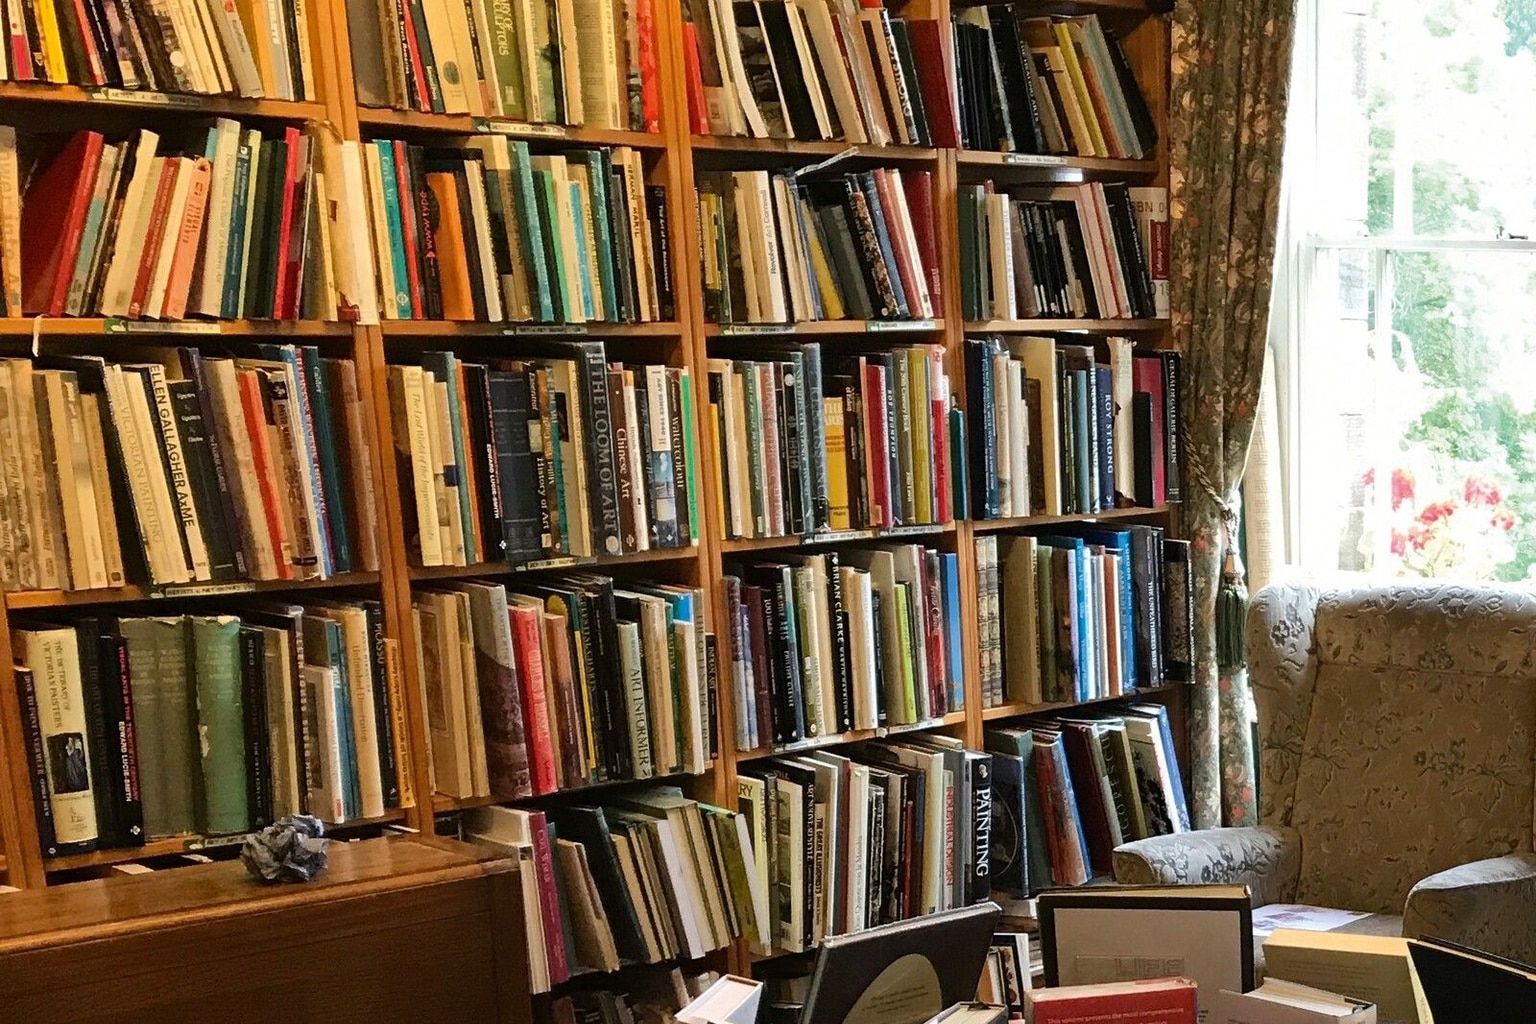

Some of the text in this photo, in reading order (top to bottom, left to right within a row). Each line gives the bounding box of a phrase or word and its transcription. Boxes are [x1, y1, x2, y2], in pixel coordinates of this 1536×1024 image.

[147, 364, 196, 527] ELLEN GALLAGHER AxME
[485, 443, 494, 473] EDWARD
[590, 368, 617, 531] THE LOOM OF ART
[613, 427, 632, 498] Chinese Art
[1103, 394, 1117, 473] ROY STRONG
[534, 457, 549, 529] History of Art
[831, 565, 844, 642] BRIAN CLARKE
[372, 622, 387, 665] PICASSO
[629, 667, 642, 694] ART
[41, 641, 62, 728] VICTORIAN PAINTERS
[117, 720, 132, 801] EDWARD LUCIE-SMITH
[976, 787, 992, 877] PAINTING
